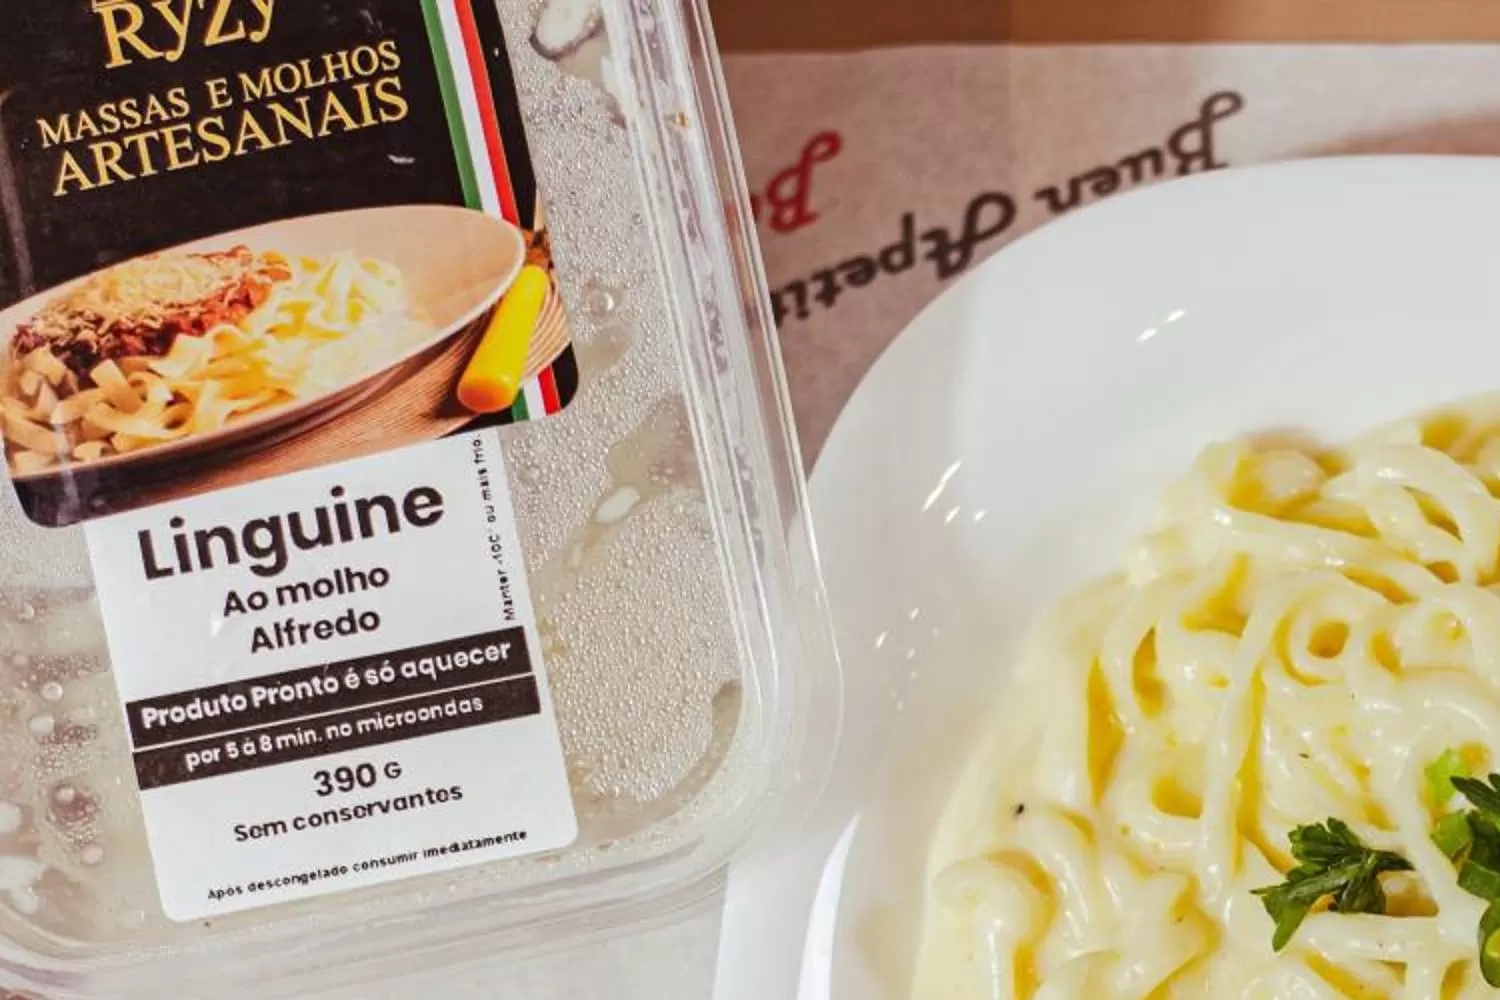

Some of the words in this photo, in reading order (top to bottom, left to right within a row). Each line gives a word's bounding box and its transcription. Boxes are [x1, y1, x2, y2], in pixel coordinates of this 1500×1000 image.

[37, 88, 190, 149] MASSAS
[208, 80, 234, 109] E
[240, 41, 400, 101] MOLHOS
[53, 75, 410, 196] ARTESANAIS
[477, 467, 492, 501] mais
[137, 484, 446, 581] Linguine
[223, 587, 268, 618] Ao
[277, 563, 391, 607] molho
[250, 608, 381, 654] Alfredo
[141, 695, 247, 729] Produto
[251, 678, 339, 710] Pronto
[343, 668, 361, 690] é
[366, 659, 396, 686] só
[401, 642, 512, 683] aquecer
[185, 747, 221, 773] por
[227, 741, 240, 760] 5
[260, 735, 273, 753] 8
[275, 725, 322, 750] min.
[326, 721, 353, 740] no
[356, 695, 484, 733] microondas
[234, 821, 288, 843] Sem
[293, 785, 464, 831] conservantes
[313, 763, 377, 797] 390
[384, 761, 403, 779] G
[207, 884, 243, 901] Após
[247, 864, 348, 894] descongelado
[353, 851, 417, 873] consumir
[422, 829, 528, 859] imediatamente
